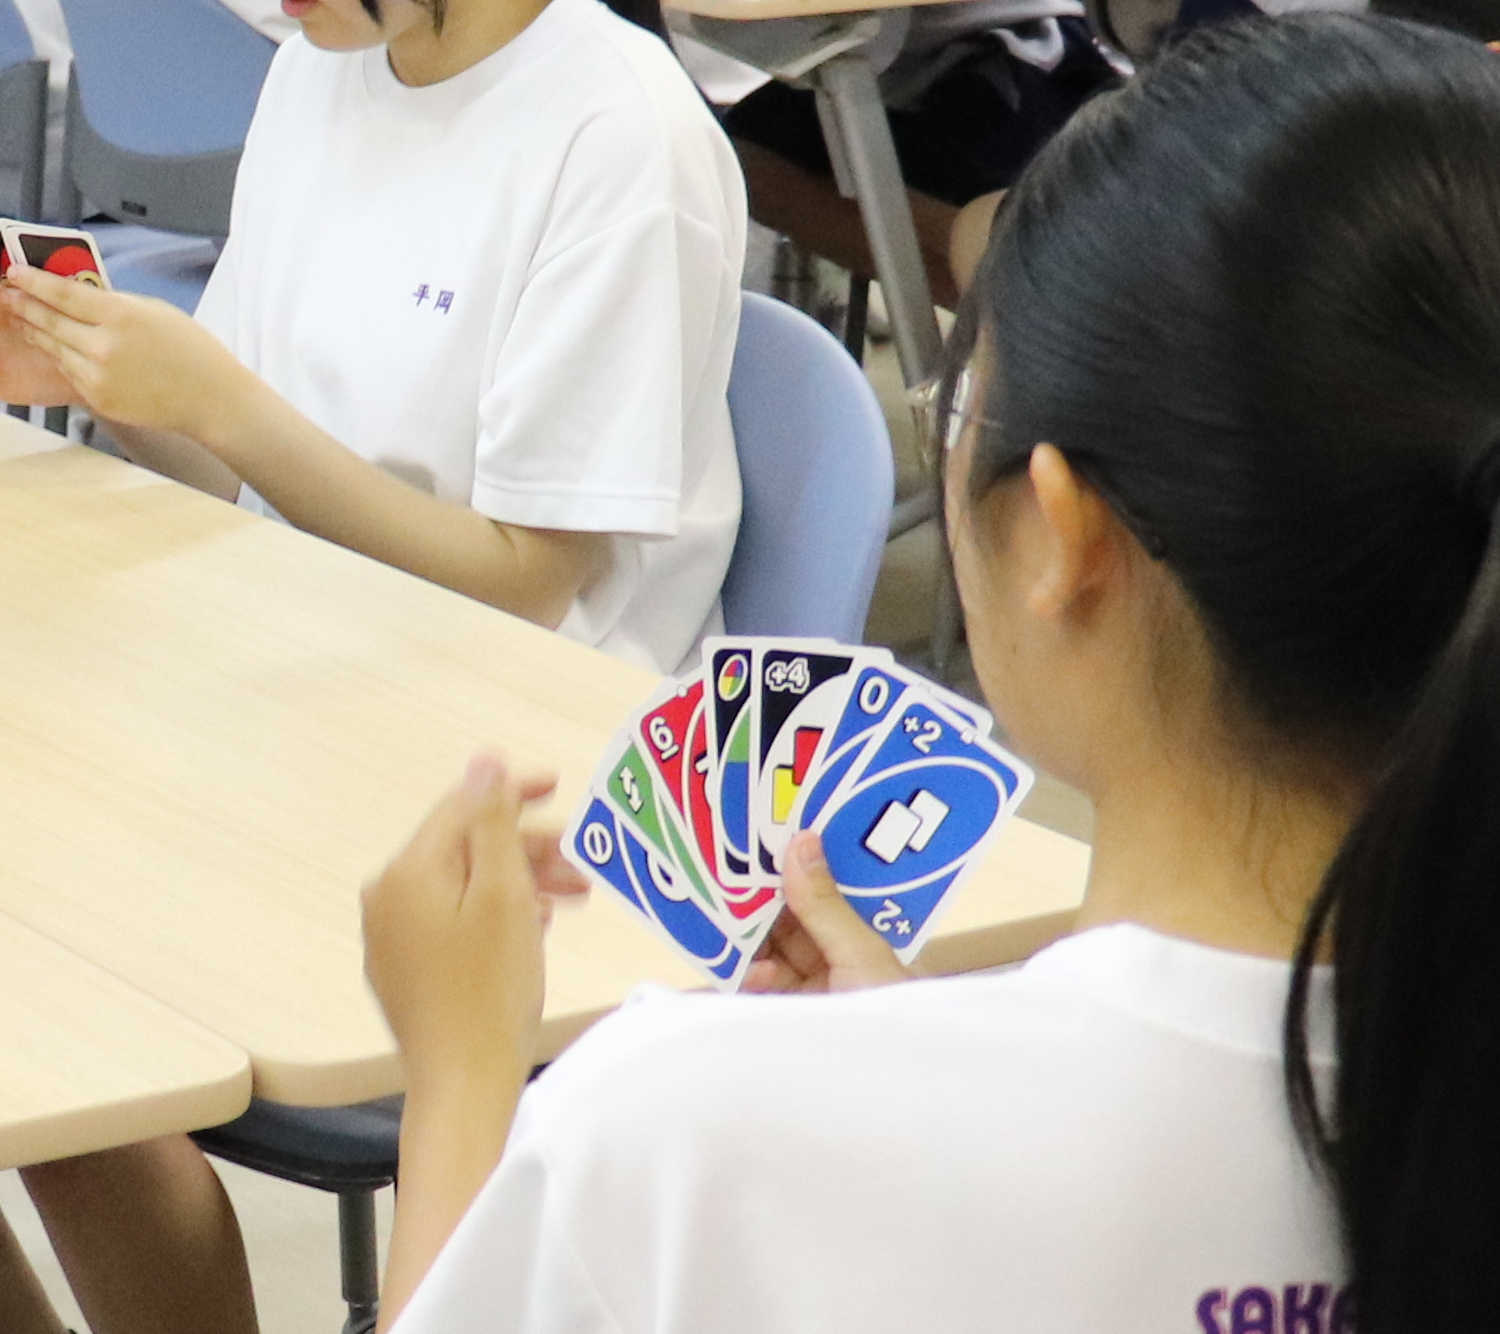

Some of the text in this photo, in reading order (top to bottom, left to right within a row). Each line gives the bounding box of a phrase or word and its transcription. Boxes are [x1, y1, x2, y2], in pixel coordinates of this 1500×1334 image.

[766, 657, 811, 694] +4
[858, 677, 890, 715] 0
[903, 715, 943, 754] +2
